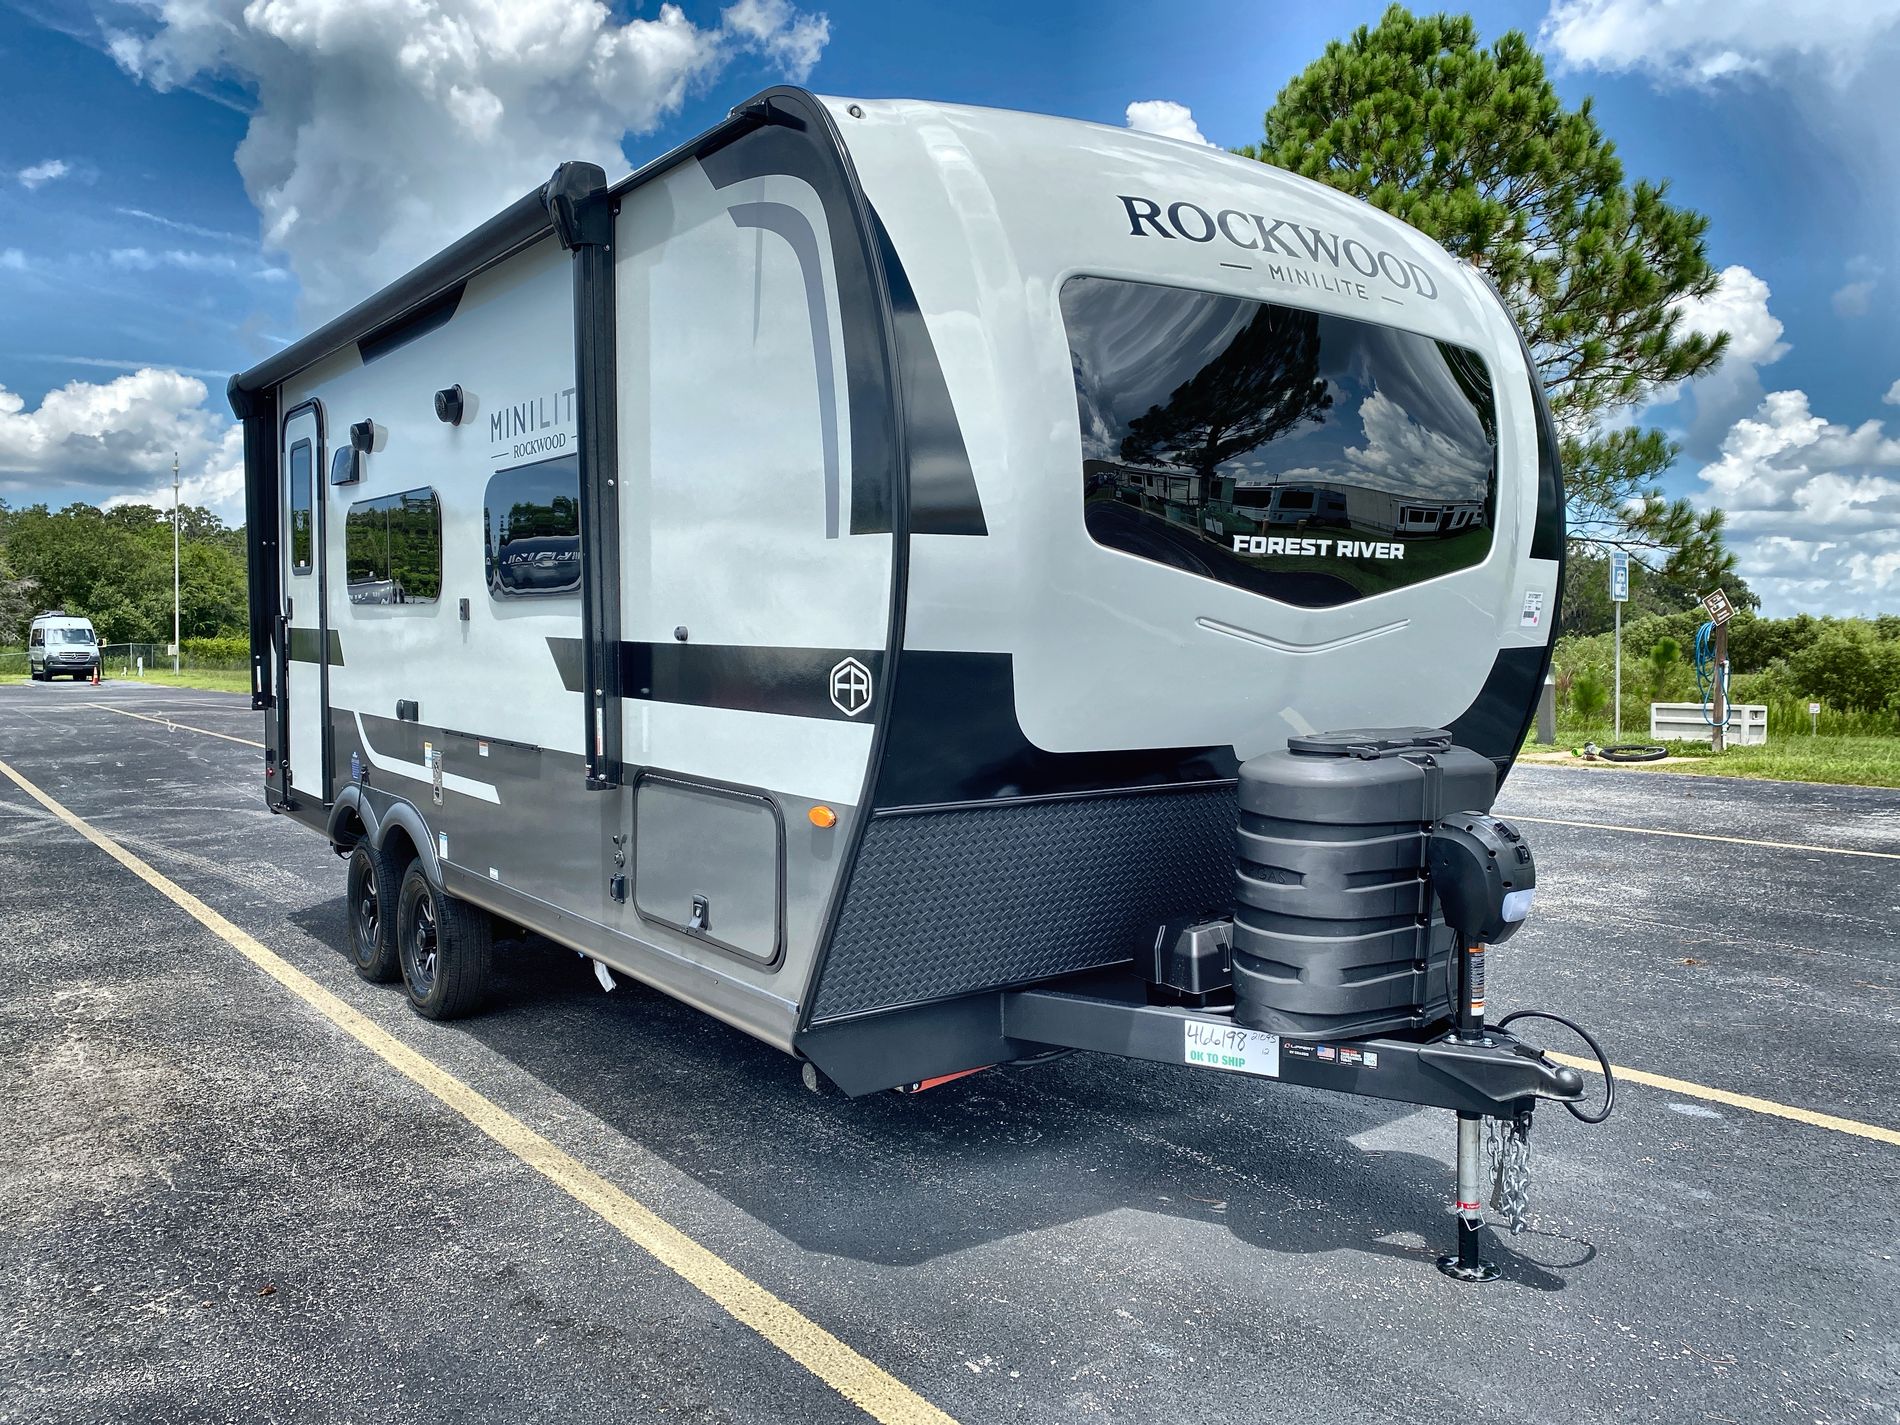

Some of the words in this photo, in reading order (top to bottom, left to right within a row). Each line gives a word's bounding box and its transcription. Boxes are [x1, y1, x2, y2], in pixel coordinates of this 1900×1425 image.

[1116, 194, 1438, 301] ROCKWOOD
[1269, 263, 1369, 301] MINILITE
[490, 387, 577, 443] MINILIT
[513, 432, 567, 459] ROCKWOOD
[1232, 534, 1333, 557] FOREST
[1336, 540, 1405, 560] RIVER
[1187, 1023, 1248, 1052] 466198
[1190, 1050, 1205, 1062] OK
[1206, 1051, 1219, 1064] TO
[1221, 1054, 1246, 1068] SHIP
